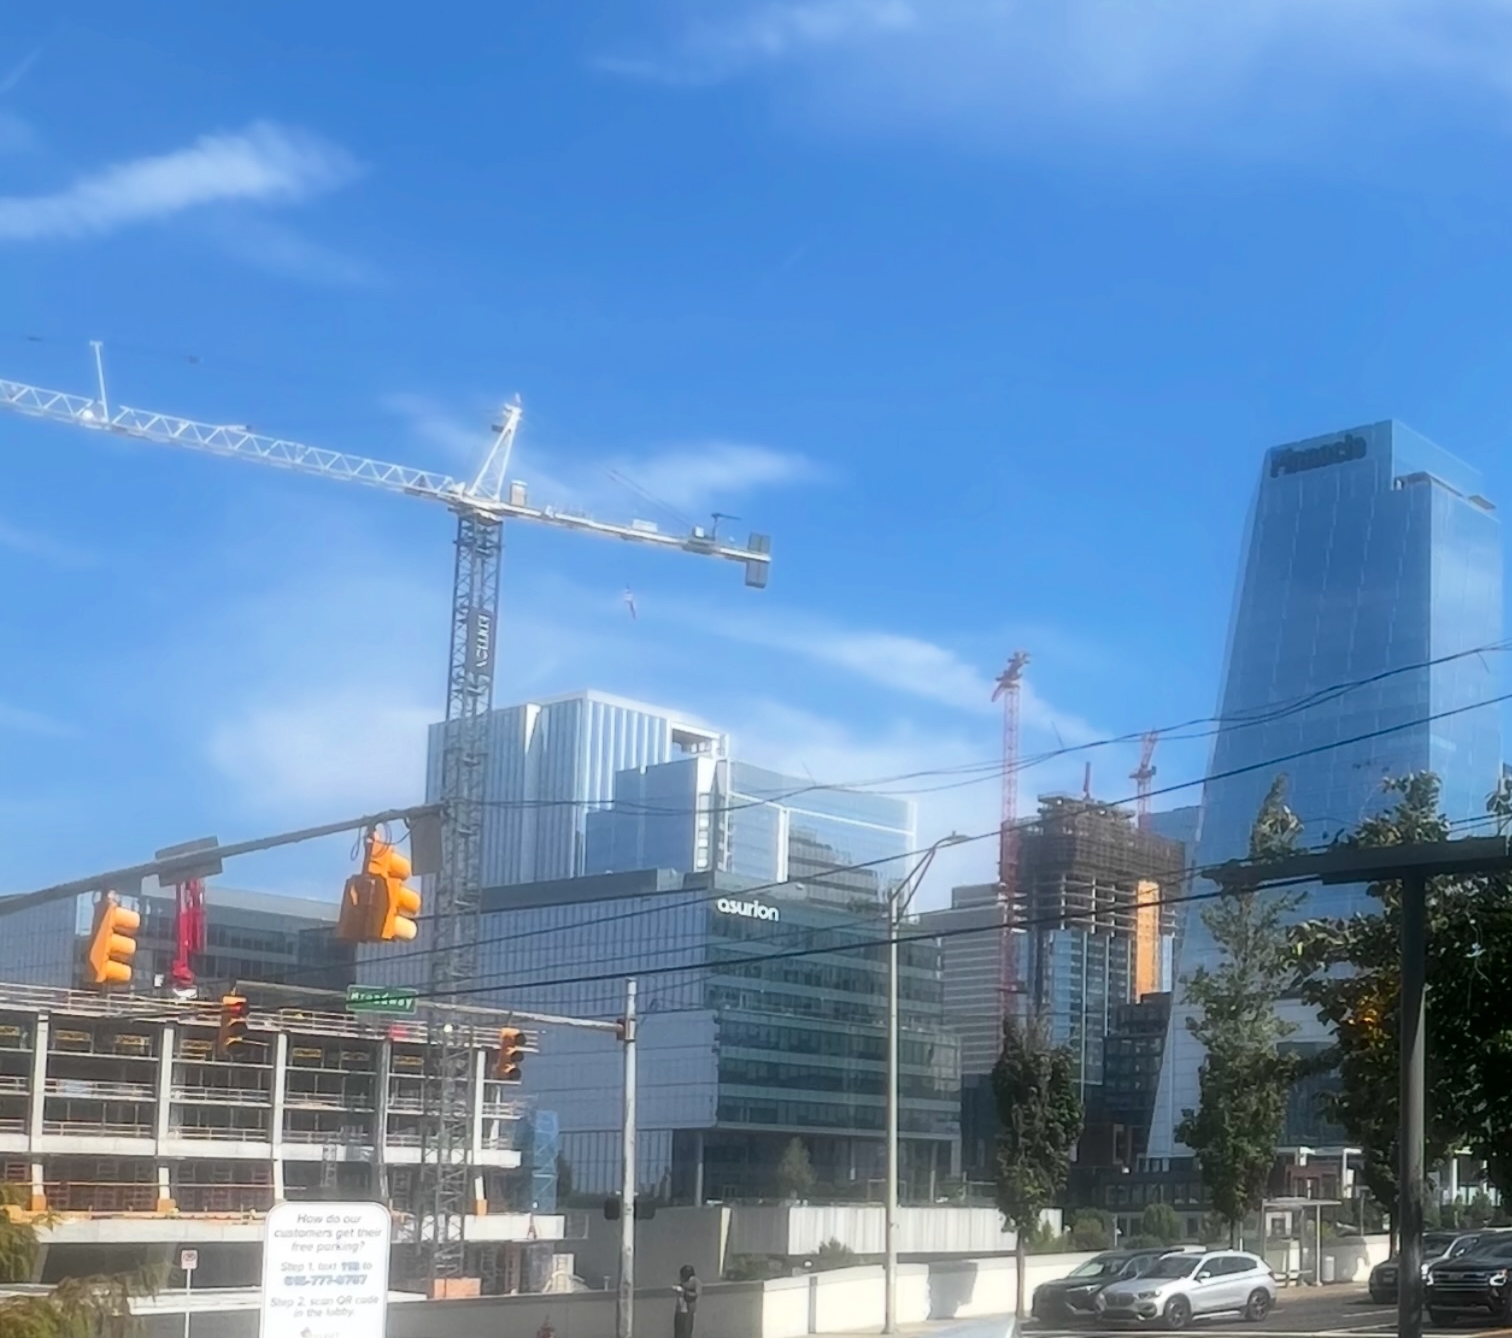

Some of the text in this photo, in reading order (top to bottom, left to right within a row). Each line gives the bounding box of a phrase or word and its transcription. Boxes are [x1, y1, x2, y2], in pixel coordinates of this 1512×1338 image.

[717, 898, 779, 921] asurion
[296, 1214, 362, 1224] How do our
[274, 1227, 382, 1240] customers get their
[291, 1240, 366, 1253] free parking?
[280, 1261, 304, 1272] Step
